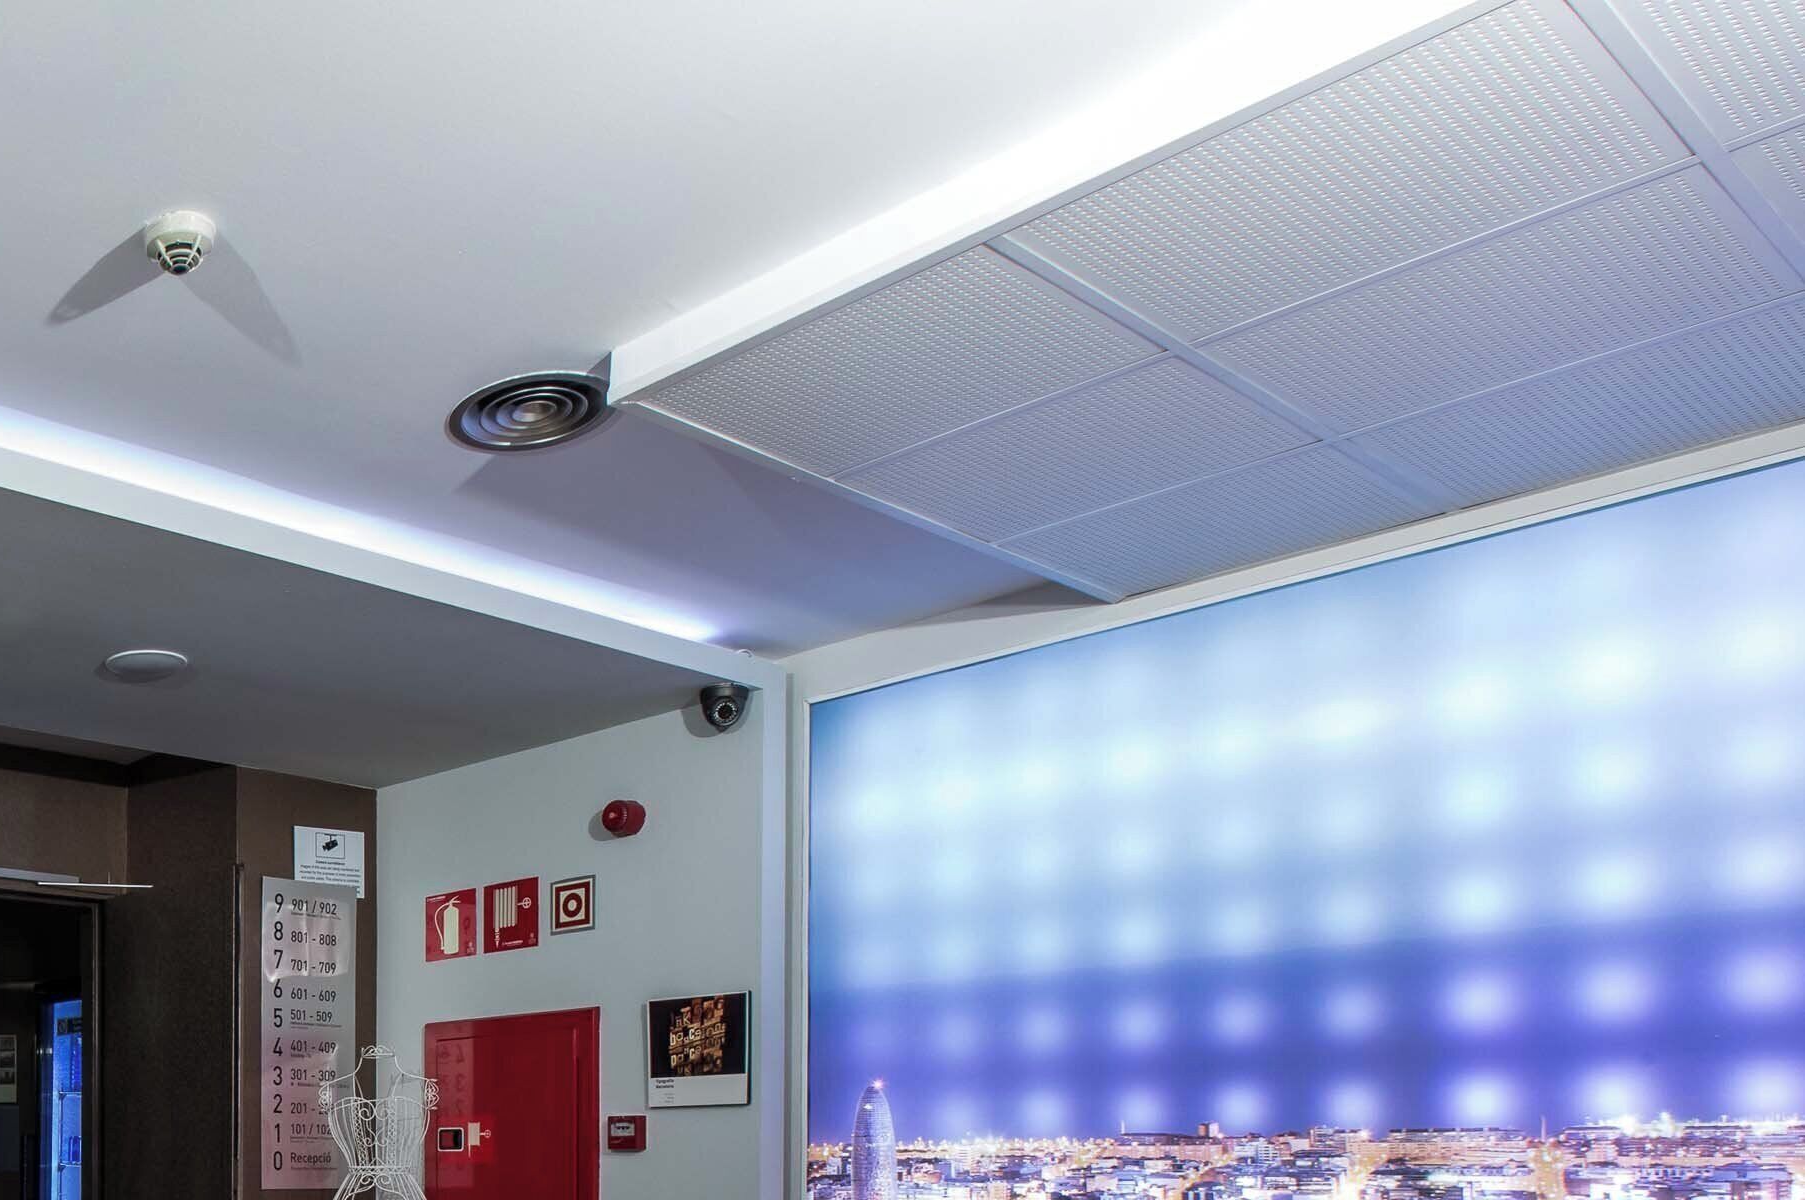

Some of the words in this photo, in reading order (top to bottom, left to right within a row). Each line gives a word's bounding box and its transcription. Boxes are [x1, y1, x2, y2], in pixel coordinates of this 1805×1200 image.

[275, 893, 284, 913] 9
[291, 898, 308, 911] 901
[319, 902, 337, 915] 902
[274, 921, 283, 941] 8
[291, 931, 308, 943] 801
[319, 933, 337, 946] 808
[274, 949, 283, 969] 7
[291, 959, 308, 971] 701
[319, 961, 336, 975] 709
[274, 979, 283, 998] 6
[291, 988, 307, 1000] 601
[319, 990, 336, 1002] 609
[274, 1008, 283, 1028] 5
[291, 1009, 306, 1020] 501
[316, 1010, 333, 1022] 509
[273, 1037, 283, 1056] 4
[291, 1040, 307, 1052] 401
[319, 1041, 336, 1054] 409
[273, 1066, 282, 1086] 3
[291, 1068, 307, 1080] 301
[274, 1094, 283, 1114] 2
[291, 1102, 307, 1114] 201
[275, 1123, 280, 1143] 1
[291, 1123, 306, 1134] 101
[316, 1124, 332, 1135] 102
[274, 1151, 282, 1171] 0
[290, 1152, 332, 1166] Recepció
